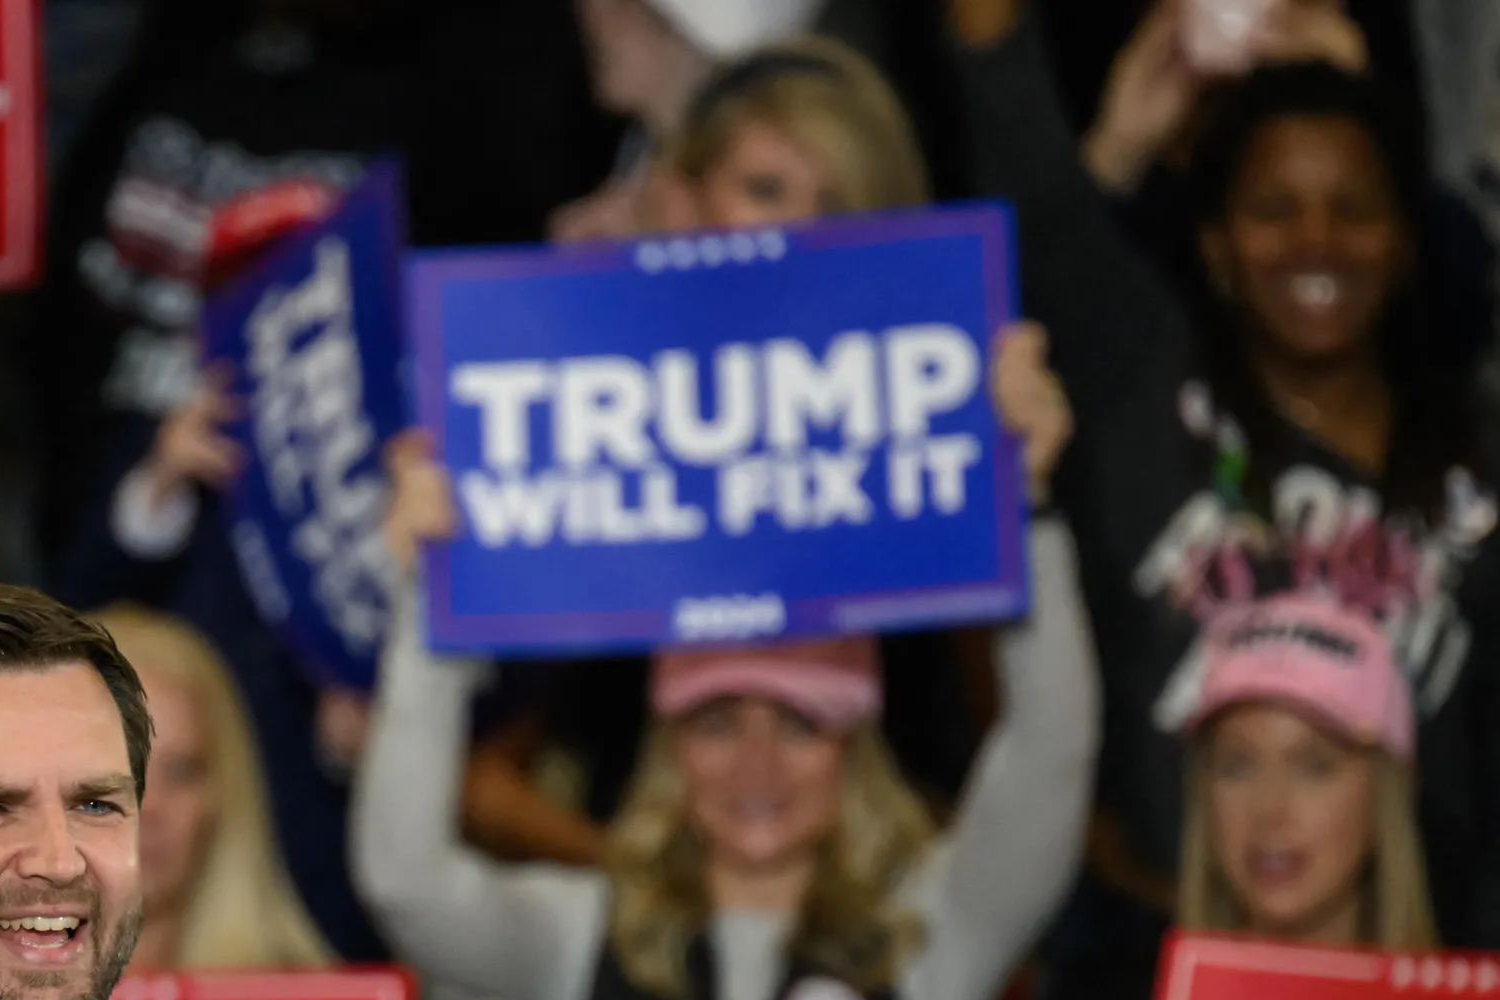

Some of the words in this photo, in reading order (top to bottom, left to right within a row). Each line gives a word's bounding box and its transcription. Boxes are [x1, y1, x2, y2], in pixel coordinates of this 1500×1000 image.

[449, 322, 981, 472] TRUMP
[461, 459, 706, 548] WILL
[718, 447, 873, 536] FIX
[887, 432, 981, 520] IT
